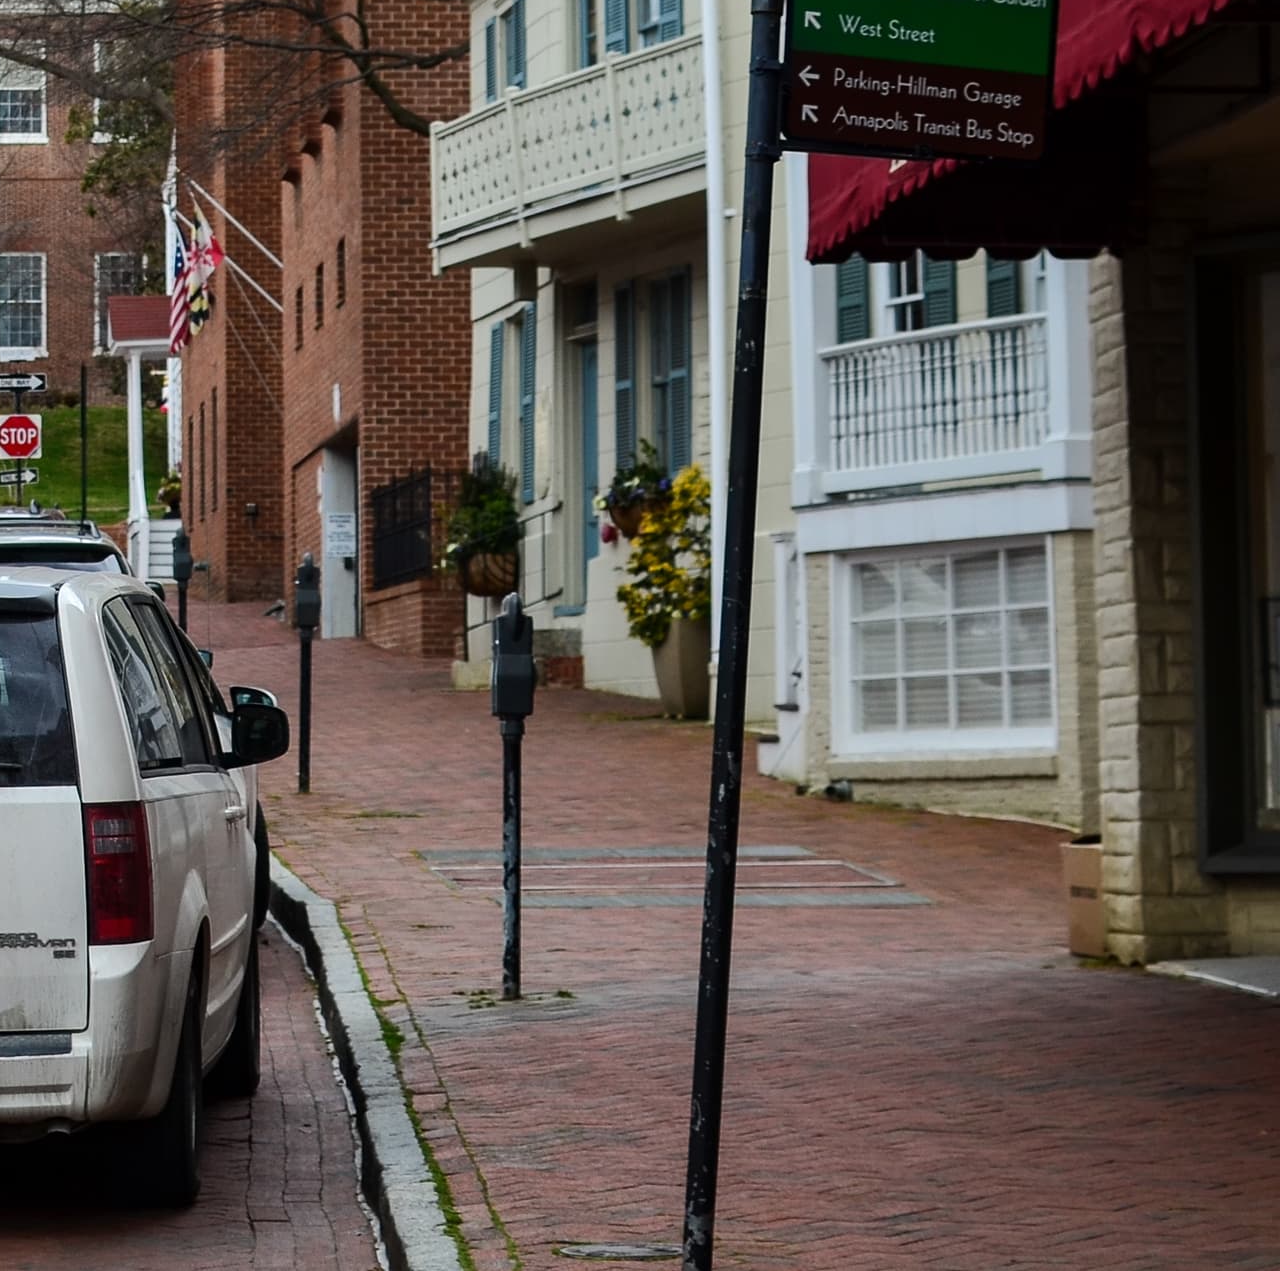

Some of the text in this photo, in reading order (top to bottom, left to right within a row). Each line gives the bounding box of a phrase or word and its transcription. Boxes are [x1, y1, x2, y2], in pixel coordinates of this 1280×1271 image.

[838, 14, 935, 43] West Street
[833, 67, 1022, 109] Parking-Hillman Garage
[832, 105, 1034, 148] Annapolis Transit Bus Stop
[0, 428, 37, 445] STOP
